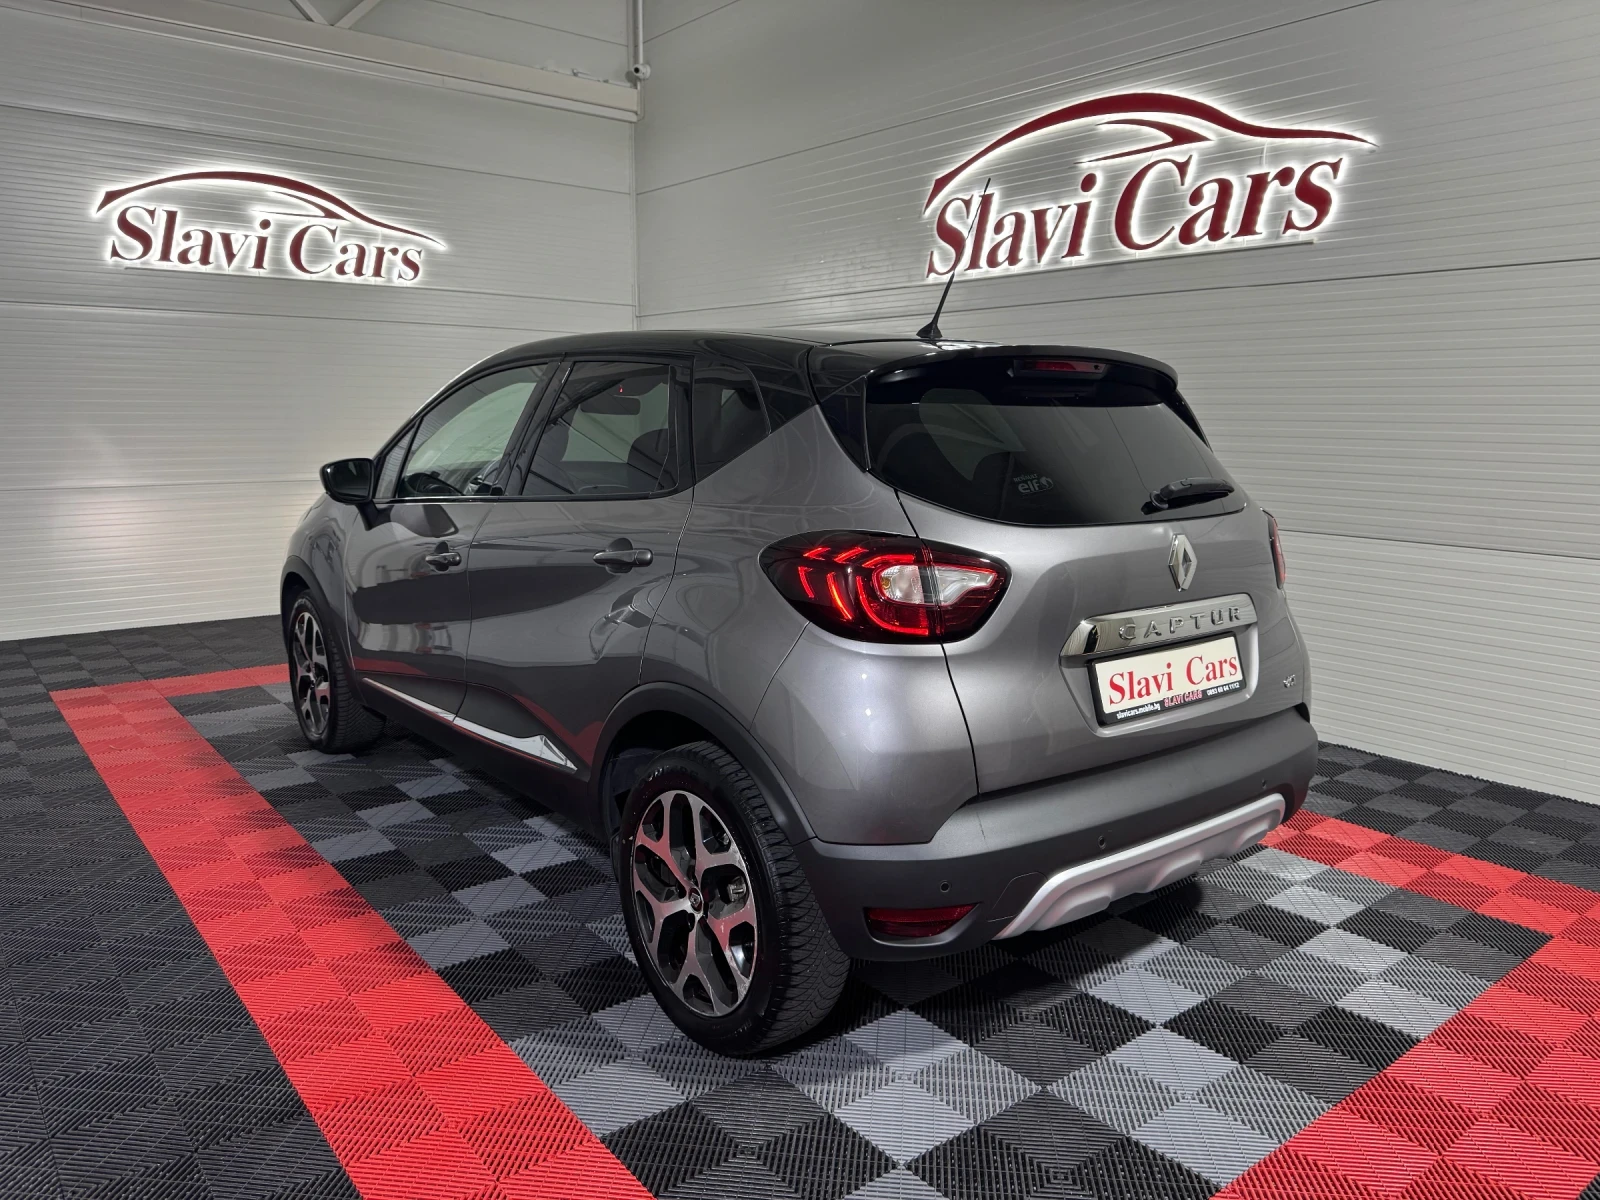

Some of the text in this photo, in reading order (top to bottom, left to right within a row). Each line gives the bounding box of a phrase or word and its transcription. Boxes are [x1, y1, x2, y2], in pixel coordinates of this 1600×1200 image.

[925, 154, 1344, 279] Slavi Cars
[110, 205, 423, 281] Slavi Cars
[1018, 479, 1040, 493] elf
[1118, 606, 1241, 640] CAPTUR
[1109, 655, 1238, 706] Slavi Cars
[1164, 690, 1203, 708] SLAVI CARS
